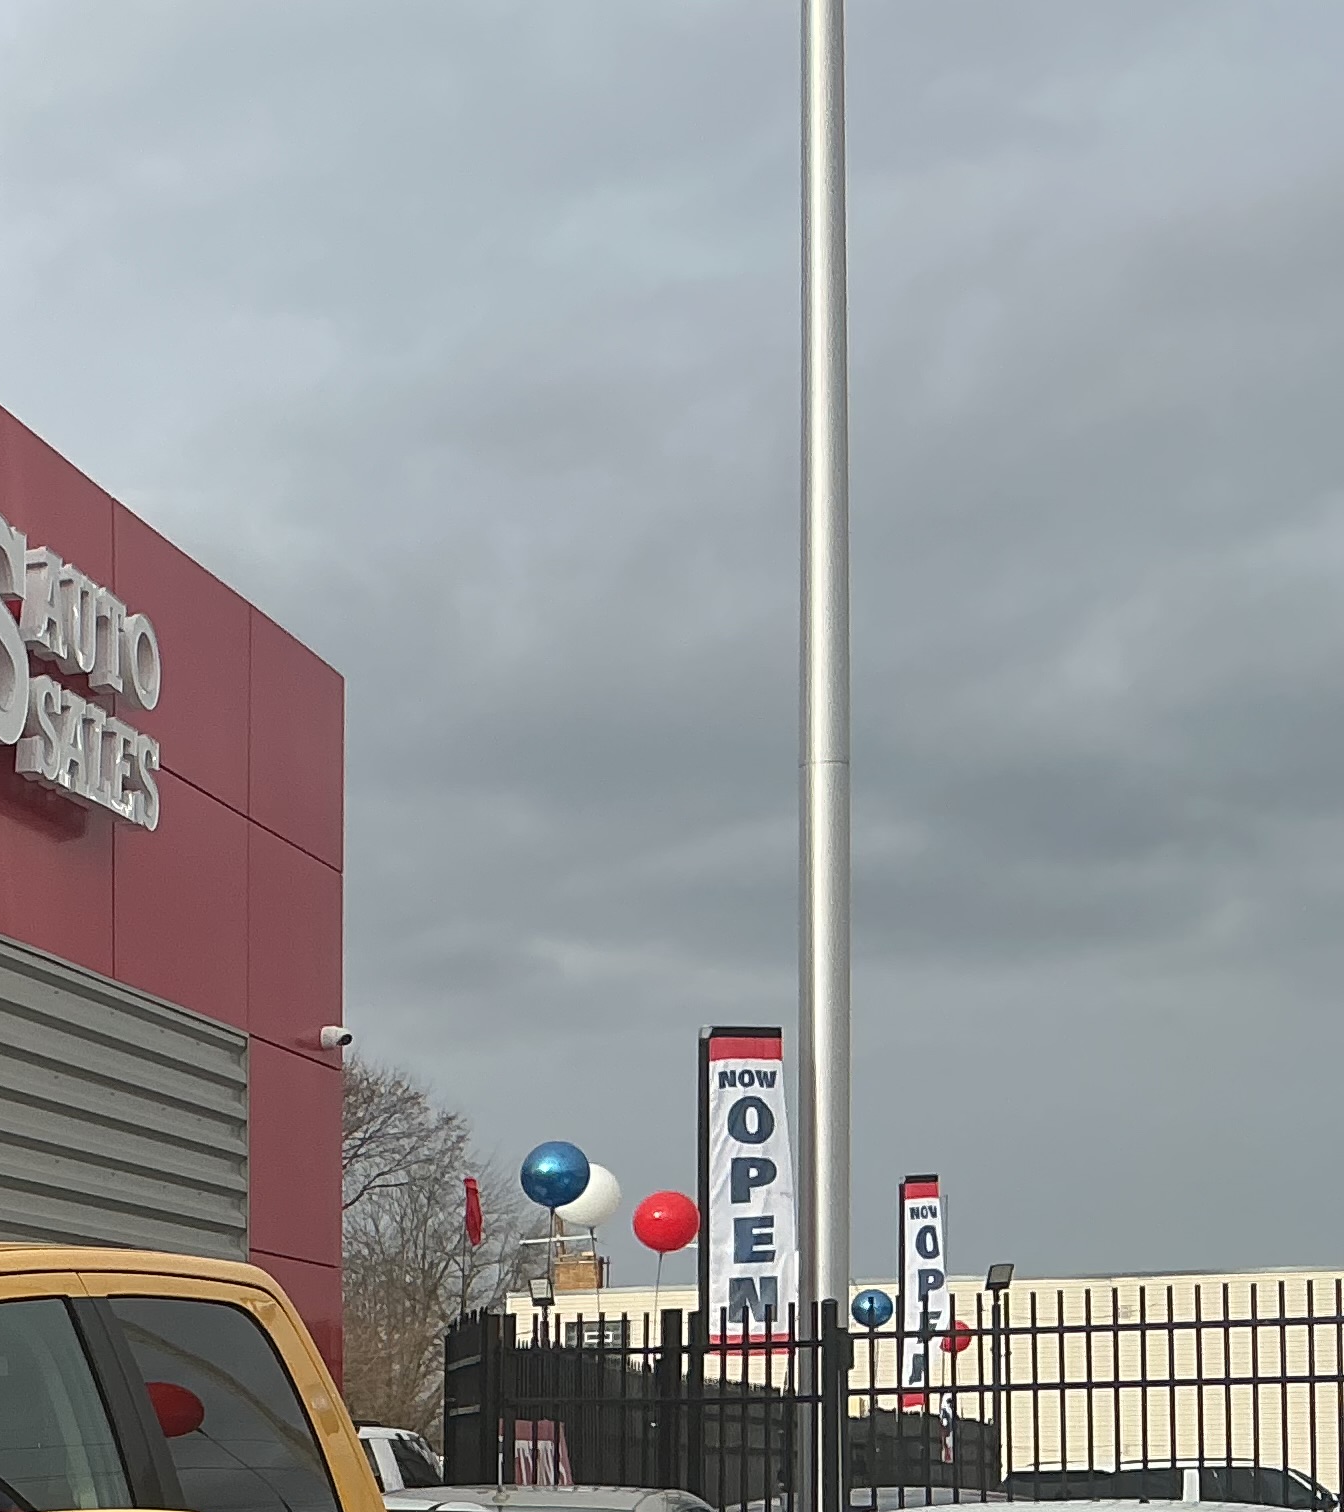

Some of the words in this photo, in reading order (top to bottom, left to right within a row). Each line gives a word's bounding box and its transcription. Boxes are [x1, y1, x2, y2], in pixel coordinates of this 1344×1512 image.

[20, 546, 161, 711] AUTO
[16, 675, 161, 831] SALES
[717, 1068, 778, 1089] NOW
[727, 1095, 779, 1324] OPEN
